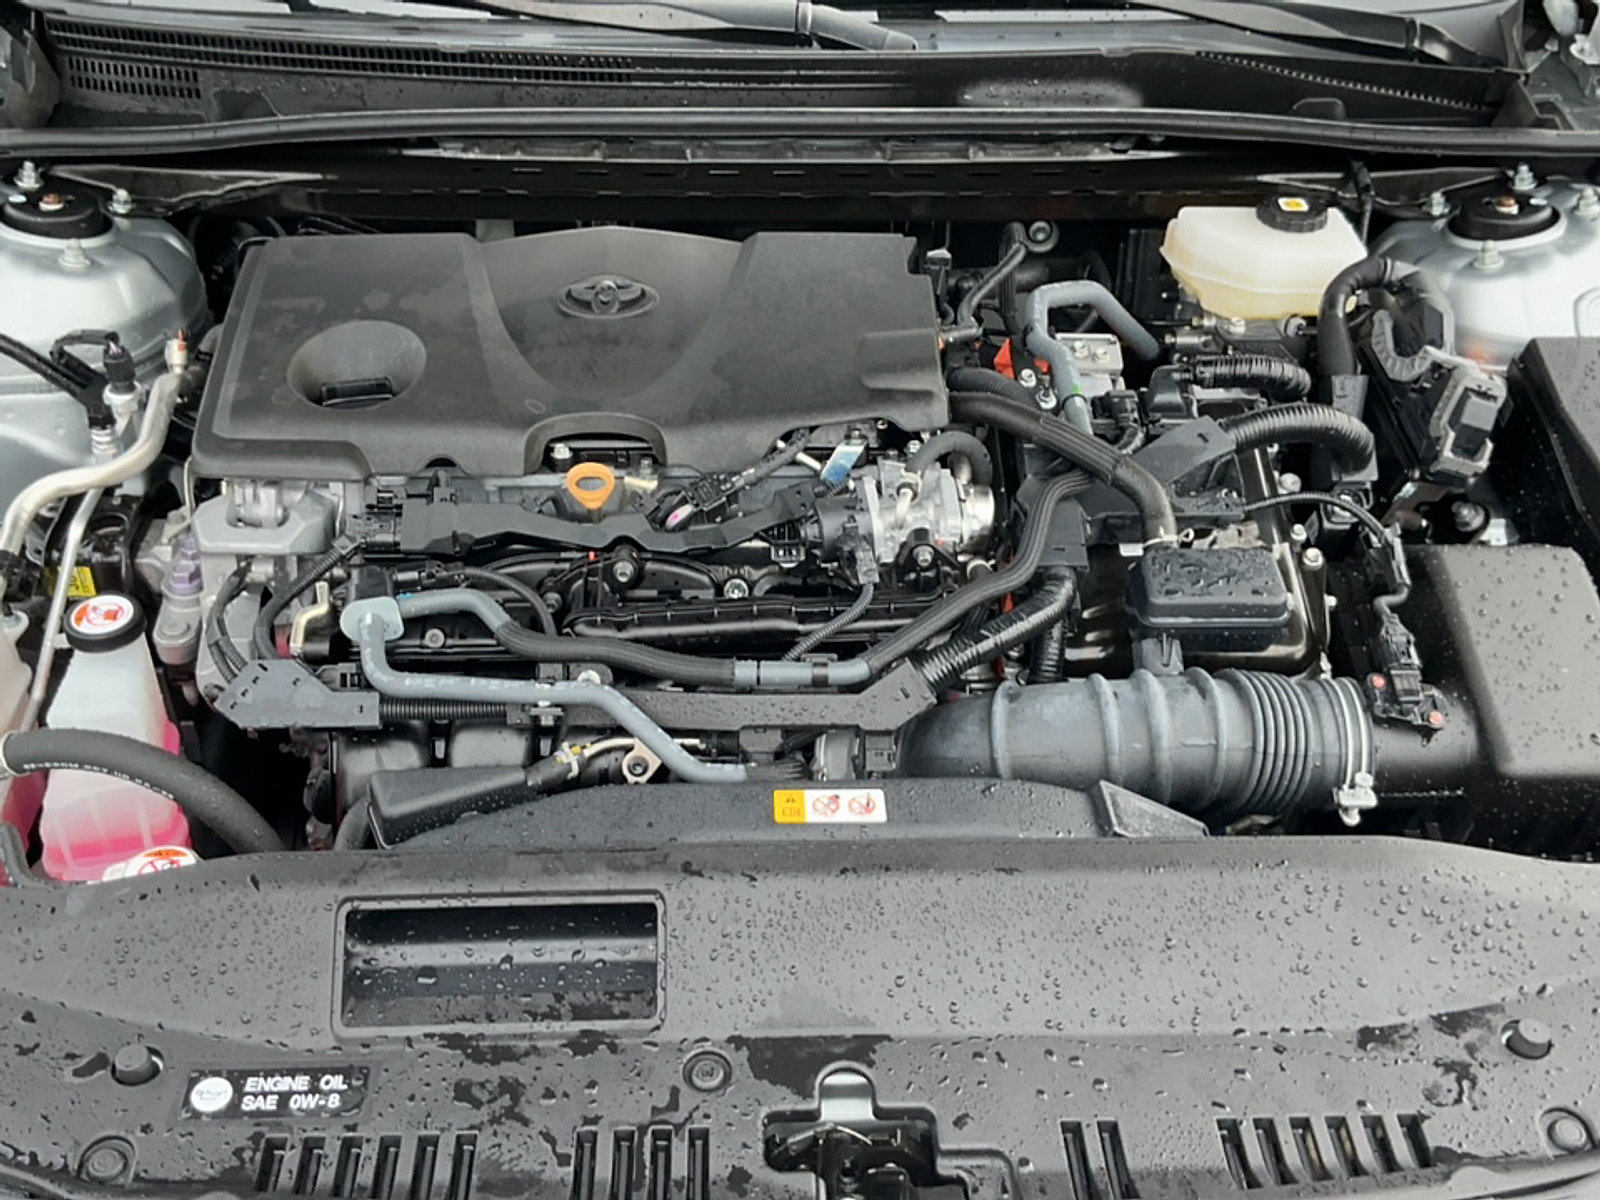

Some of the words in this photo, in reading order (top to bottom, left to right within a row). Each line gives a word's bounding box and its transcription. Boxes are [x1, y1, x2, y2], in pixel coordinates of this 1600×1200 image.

[244, 1076, 310, 1092] ENGINE
[320, 1074, 348, 1090] OIL
[241, 1094, 279, 1111] SAE
